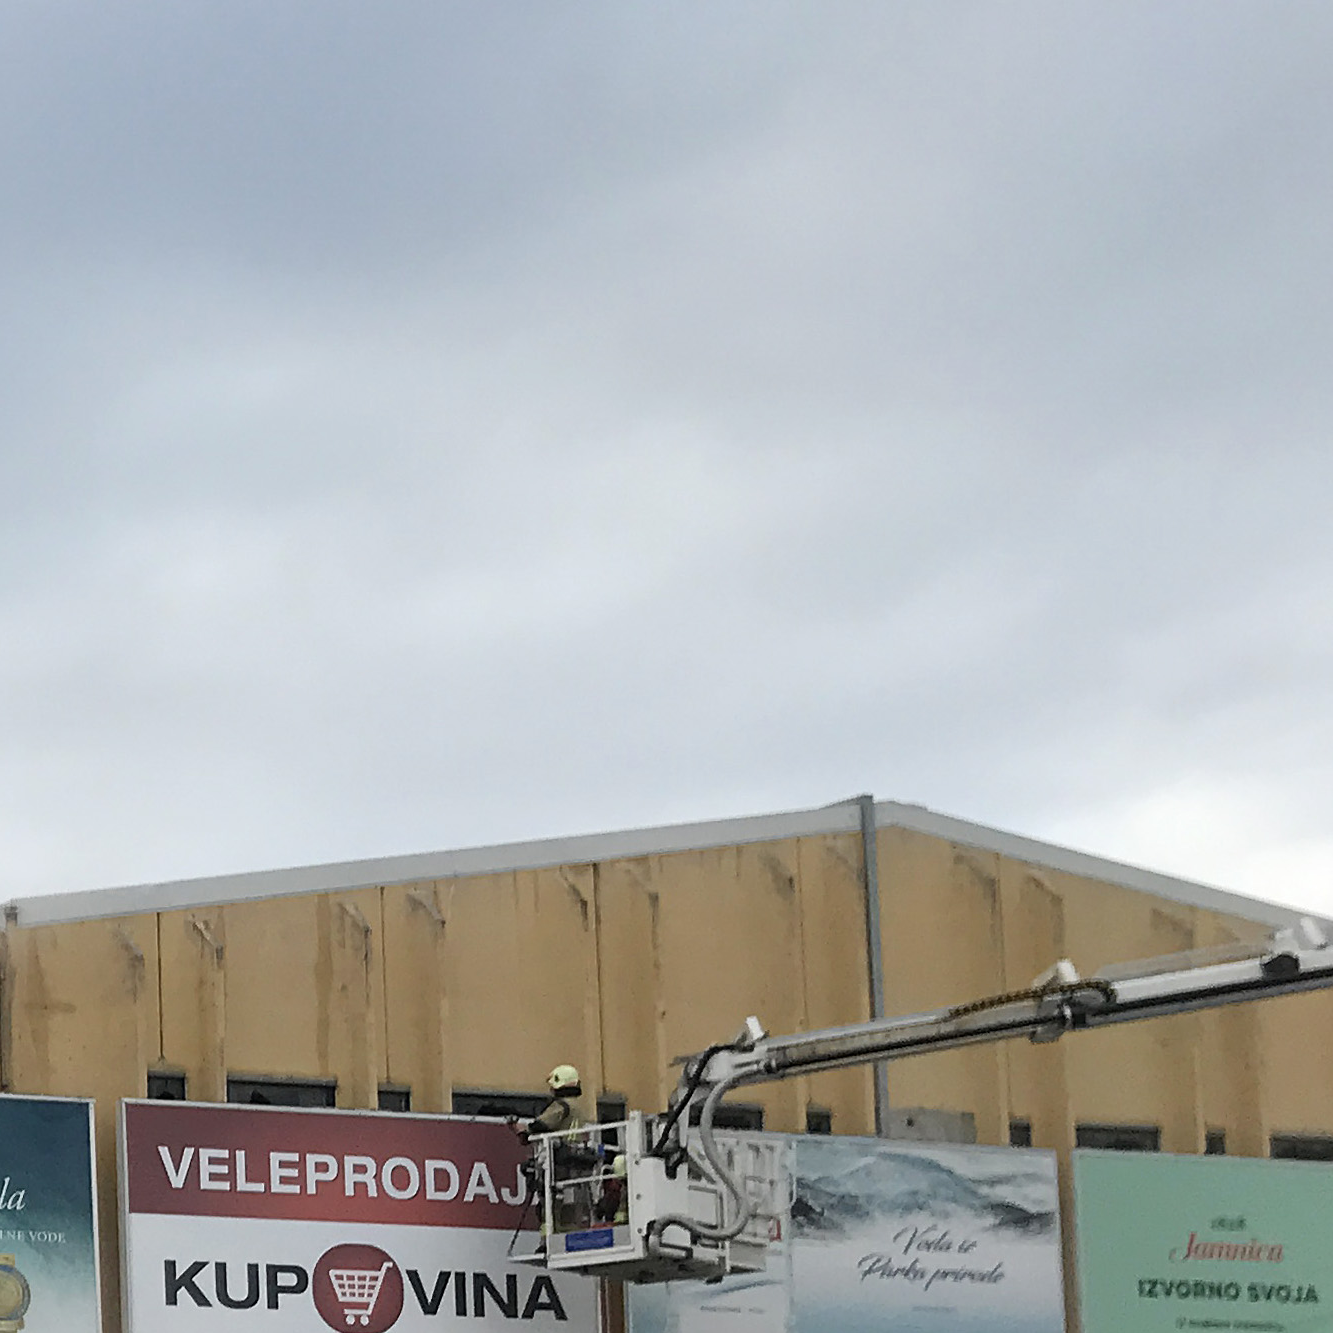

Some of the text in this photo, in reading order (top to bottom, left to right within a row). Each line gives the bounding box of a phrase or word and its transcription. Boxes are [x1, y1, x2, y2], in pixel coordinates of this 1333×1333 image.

[157, 1145, 539, 1206] VELEPRODAJ
[29, 1229, 66, 1244] VODE
[1138, 1278, 1320, 1304] IZVORNO SVOJA
